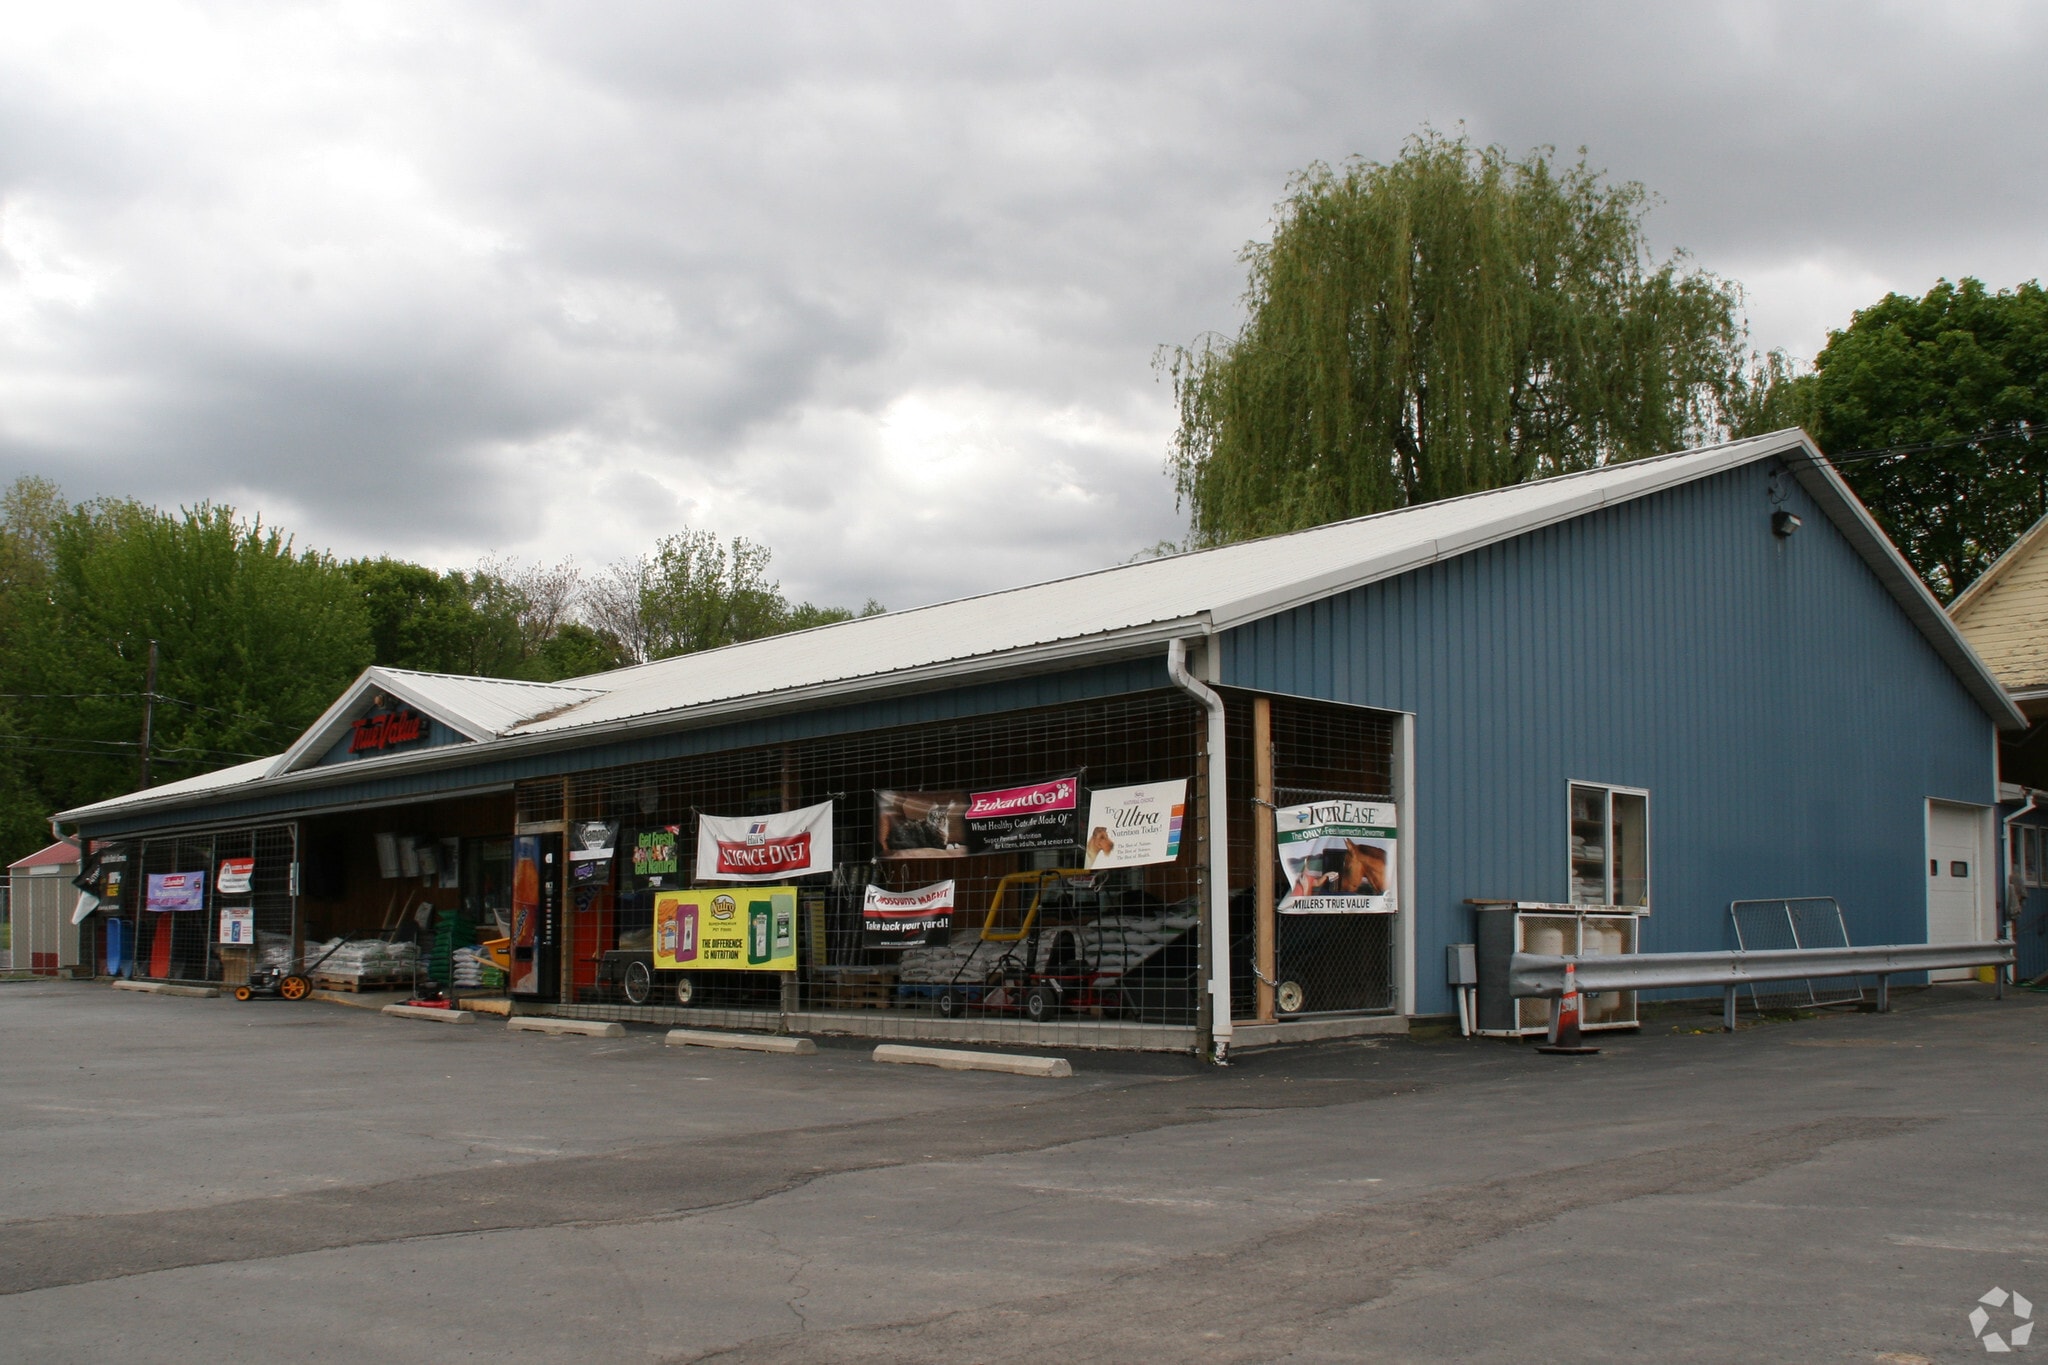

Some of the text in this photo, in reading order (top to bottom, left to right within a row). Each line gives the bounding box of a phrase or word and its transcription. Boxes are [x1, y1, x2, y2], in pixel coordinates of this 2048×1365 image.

[973, 790, 1057, 812] Eukanuba
[971, 822, 987, 831] What
[988, 820, 1013, 832] Healthy
[1039, 815, 1056, 825] Made
[1057, 813, 1068, 826] Of
[1105, 805, 1160, 828] Try Ultra
[1111, 824, 1163, 838] Nutrition Today!
[1291, 832, 1303, 841] The
[1302, 828, 1321, 839] ONLY
[639, 832, 651, 848] Get
[722, 846, 768, 866] SCIENCE
[635, 858, 677, 875] Get Natural
[711, 898, 736, 914] Nutro
[877, 895, 917, 906] MOSQUITO
[1292, 898, 1370, 909] MILLERS TRUE VALUE
[865, 917, 949, 933] Take back your yard!
[702, 938, 743, 949] THE DIFFERENCE
[703, 950, 739, 960] IS NUTRITION
